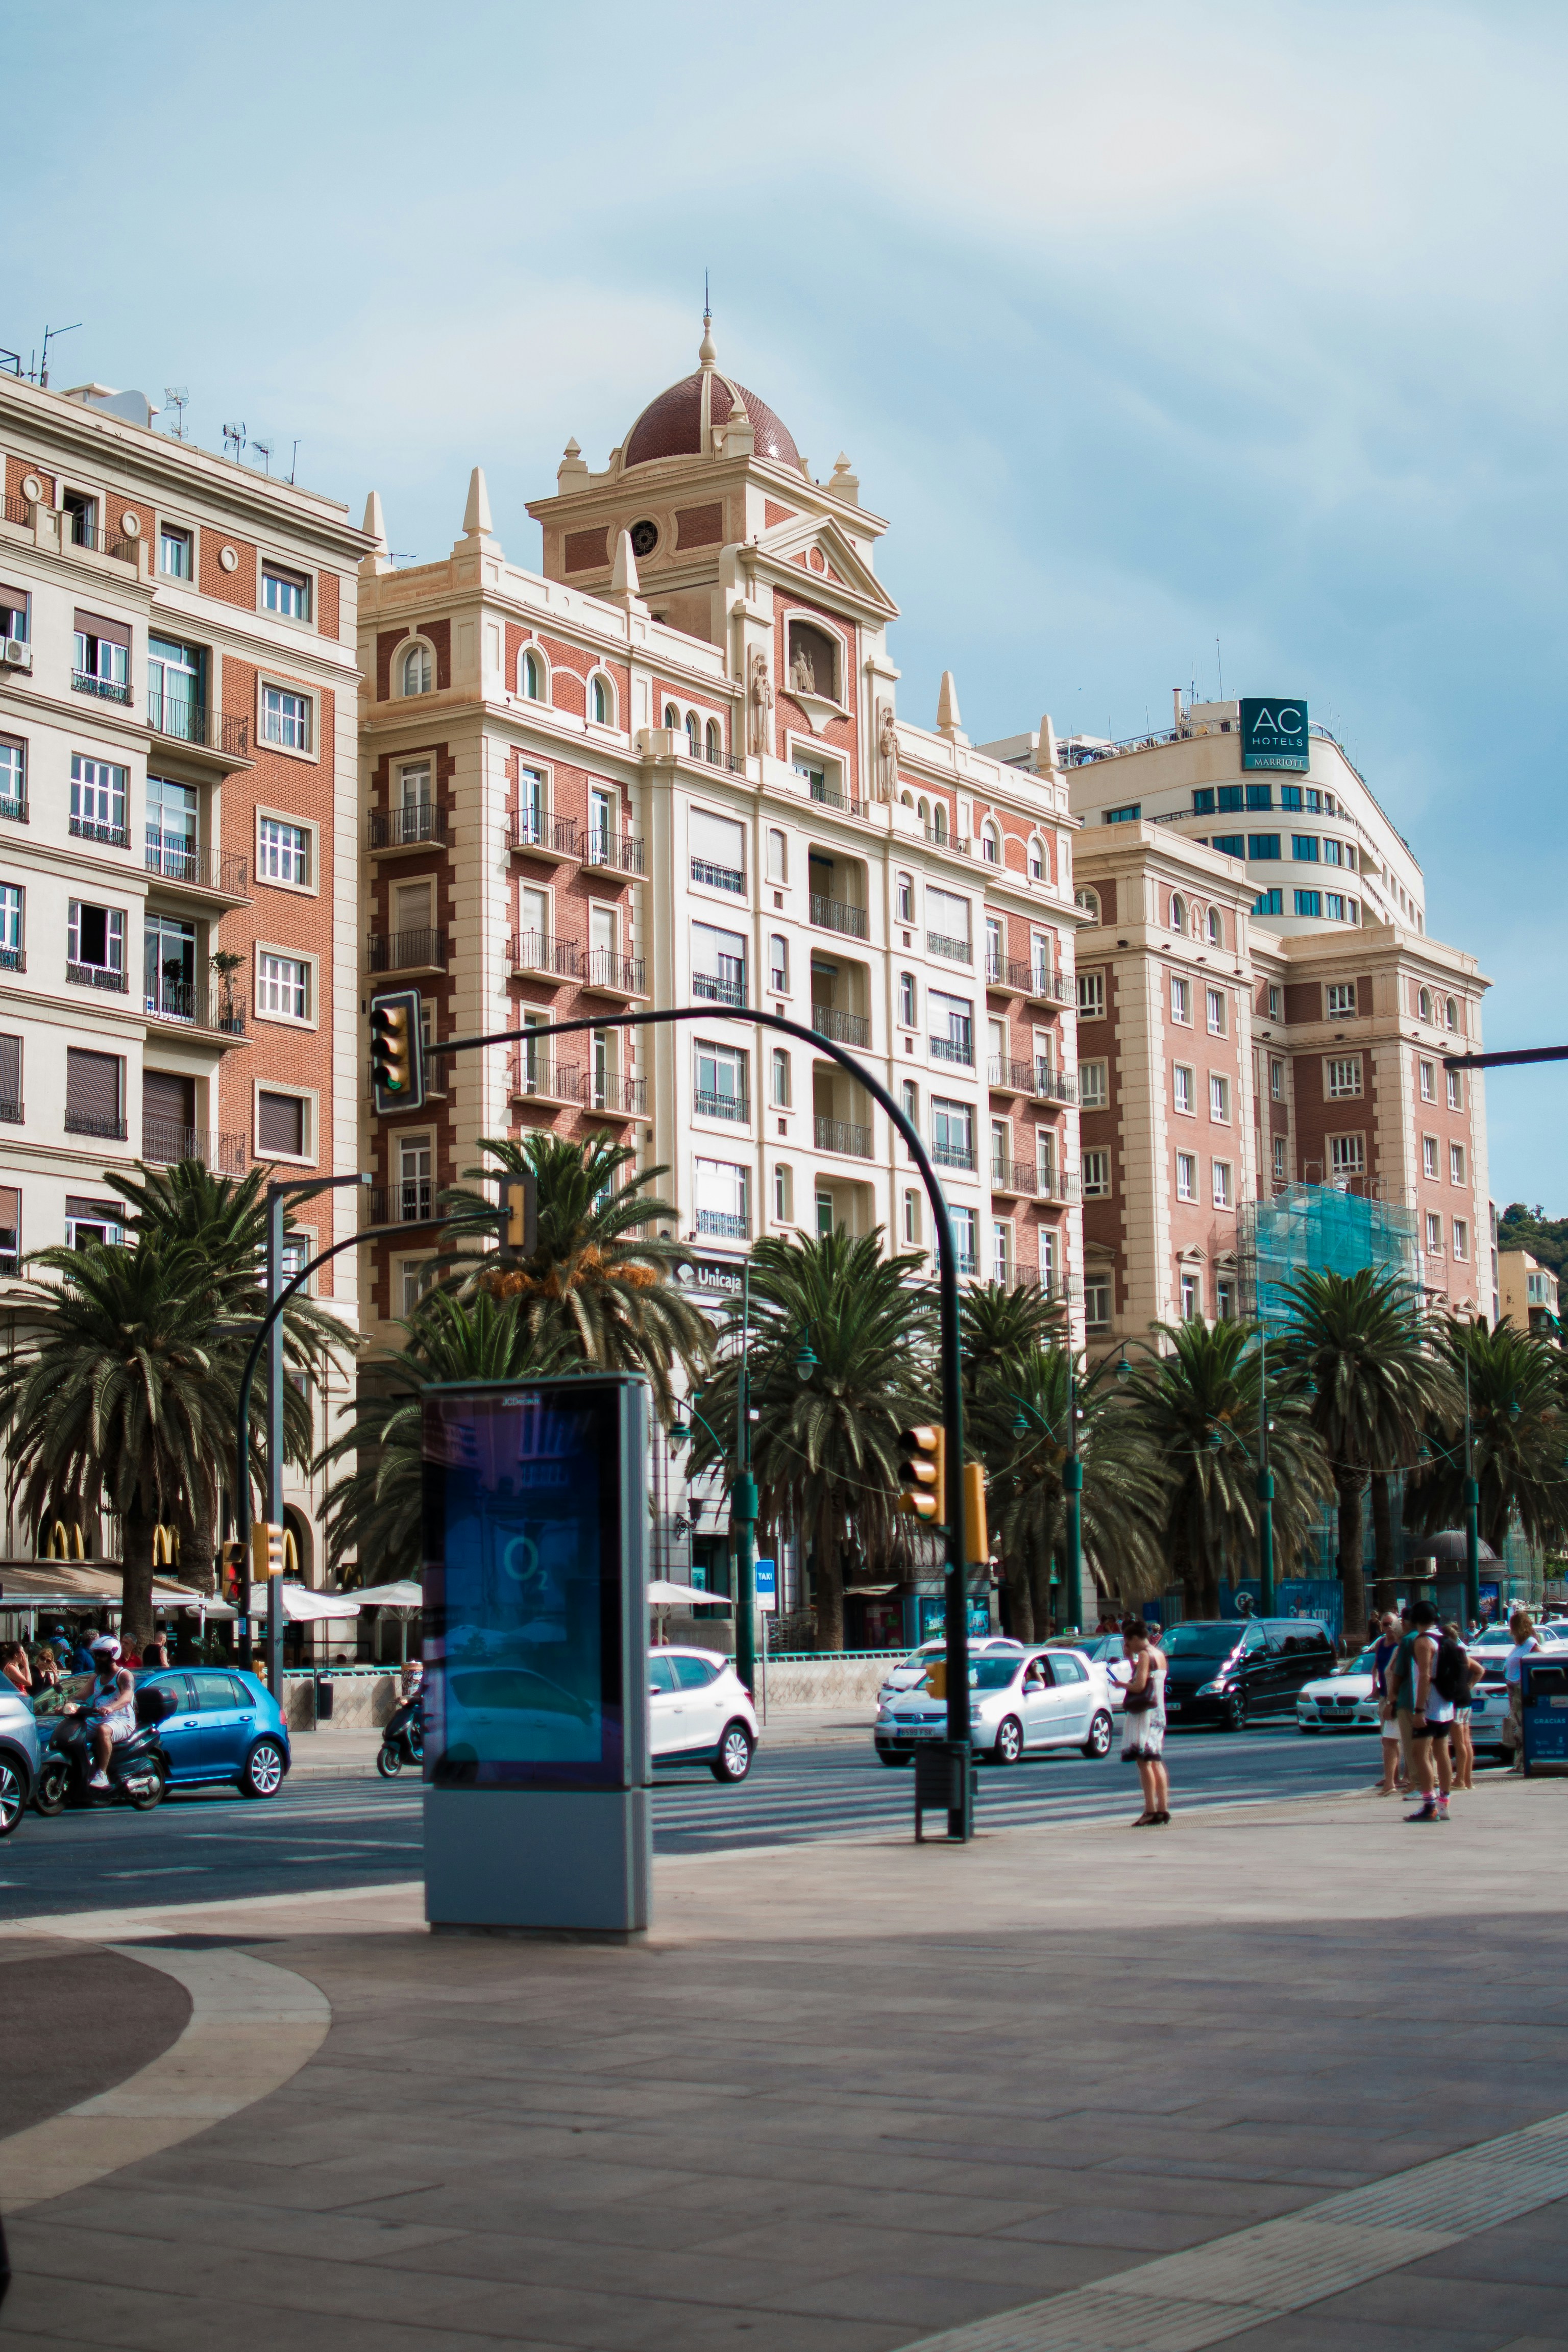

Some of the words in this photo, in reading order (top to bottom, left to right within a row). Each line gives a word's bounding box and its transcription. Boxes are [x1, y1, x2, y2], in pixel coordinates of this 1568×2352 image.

[1253, 707, 1302, 734] AC
[1253, 738, 1303, 746] HOTELS
[1254, 758, 1304, 768] MARRIOTT
[698, 1267, 742, 1294] Unicaja
